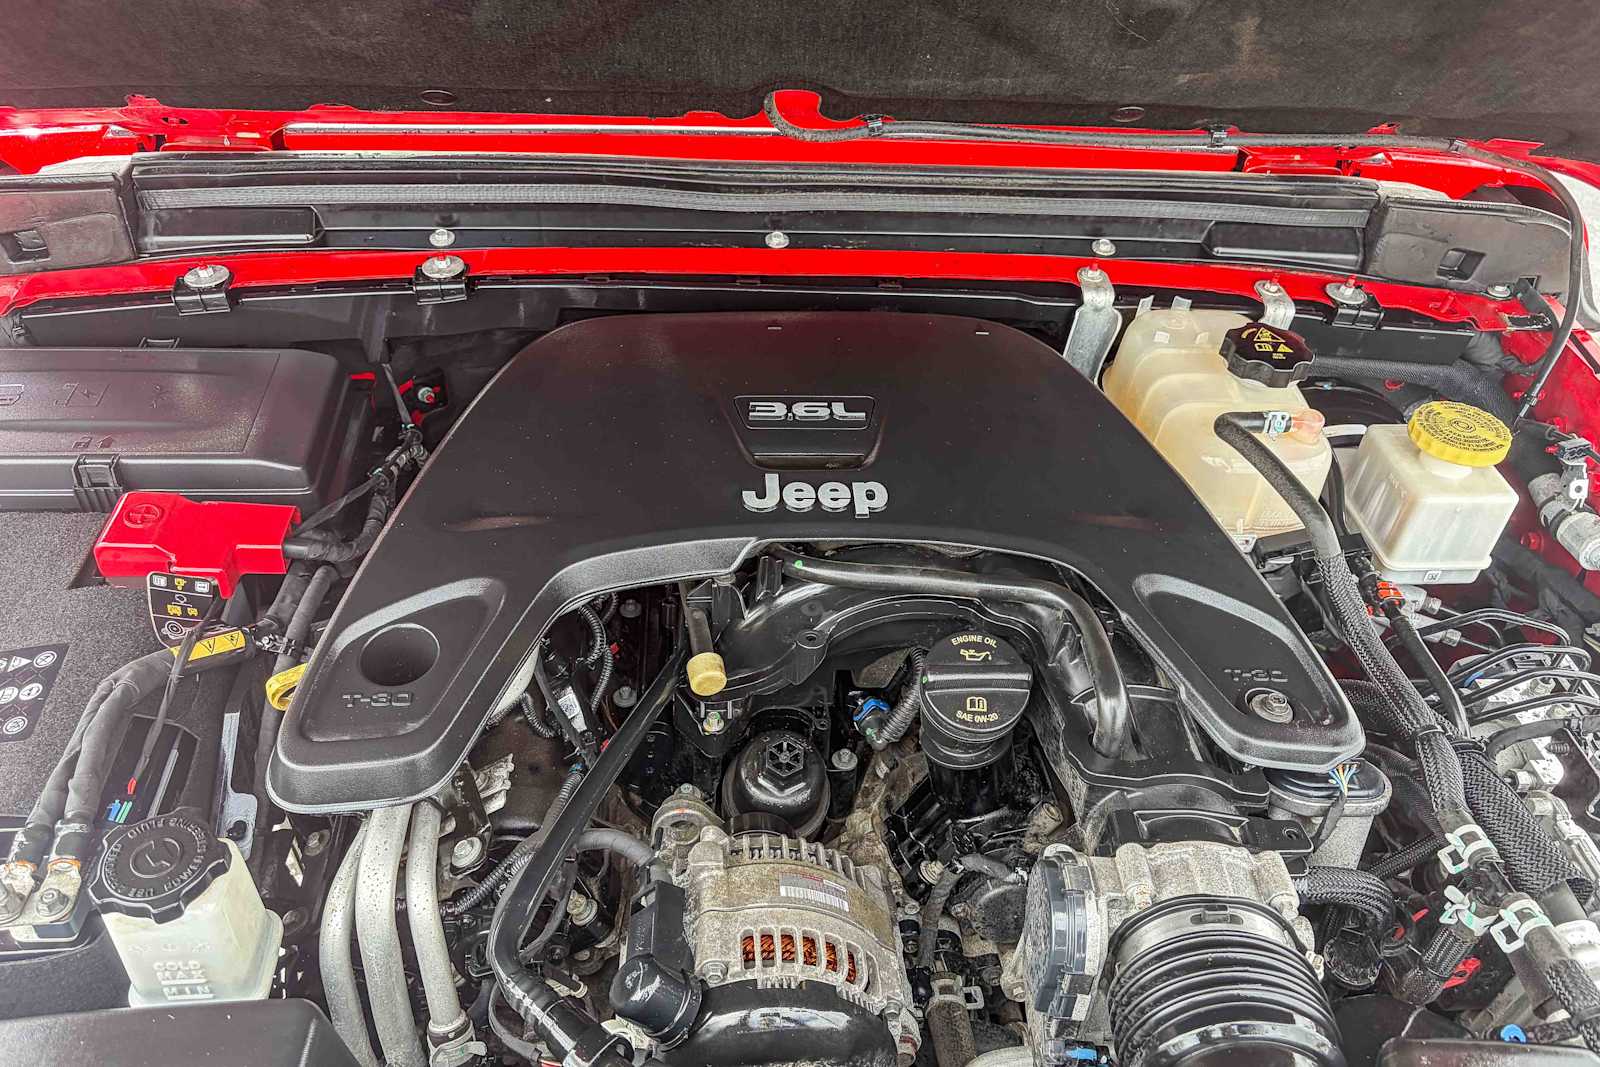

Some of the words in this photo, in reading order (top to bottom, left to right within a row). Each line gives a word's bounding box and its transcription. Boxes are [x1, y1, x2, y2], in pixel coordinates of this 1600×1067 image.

[748, 401, 867, 421] 3.6L
[741, 473, 889, 519] Jeep
[951, 634, 983, 646] ENGINE
[984, 637, 998, 648] OIL
[1223, 668, 1289, 682] T-30
[341, 692, 411, 708] T-30
[956, 710, 974, 722] SAE
[974, 712, 999, 723] 0W-20
[127, 817, 165, 840] FLUID
[163, 855, 205, 892] POWER
[153, 960, 202, 971] COLD
[156, 969, 206, 981] MAX
[162, 985, 211, 997] MIN
